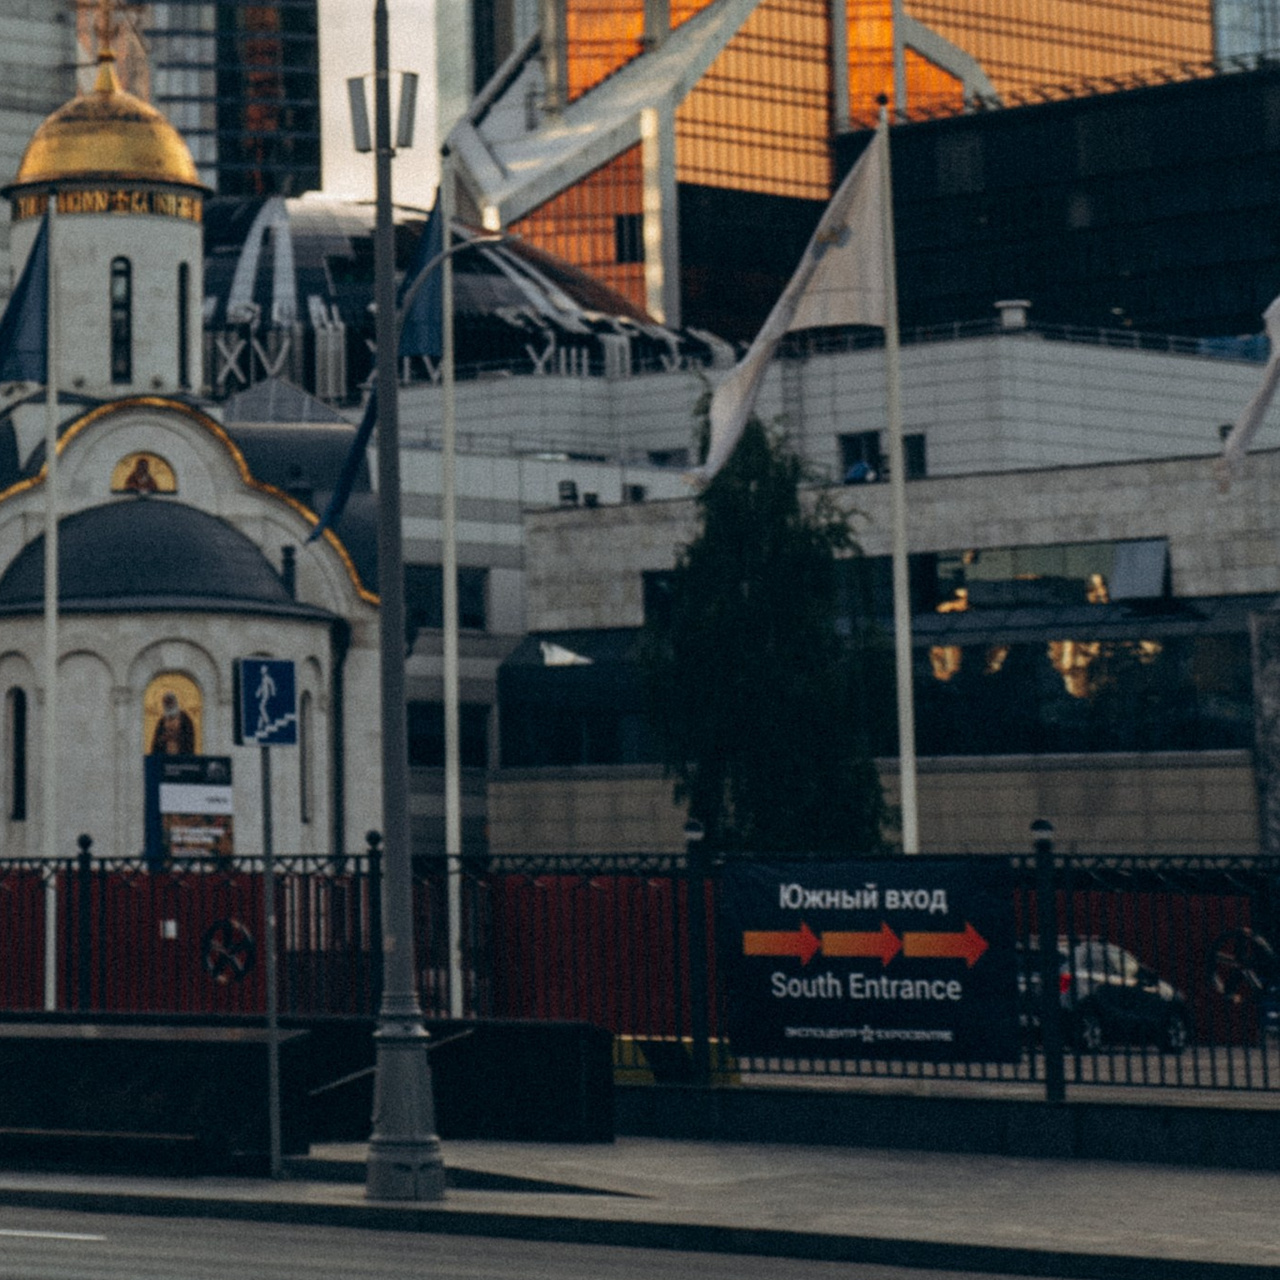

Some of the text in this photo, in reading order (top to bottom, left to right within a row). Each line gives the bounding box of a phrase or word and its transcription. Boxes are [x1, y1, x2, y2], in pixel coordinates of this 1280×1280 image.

[779, 882, 949, 915] Южный вход
[770, 971, 963, 1001] South Entrance
